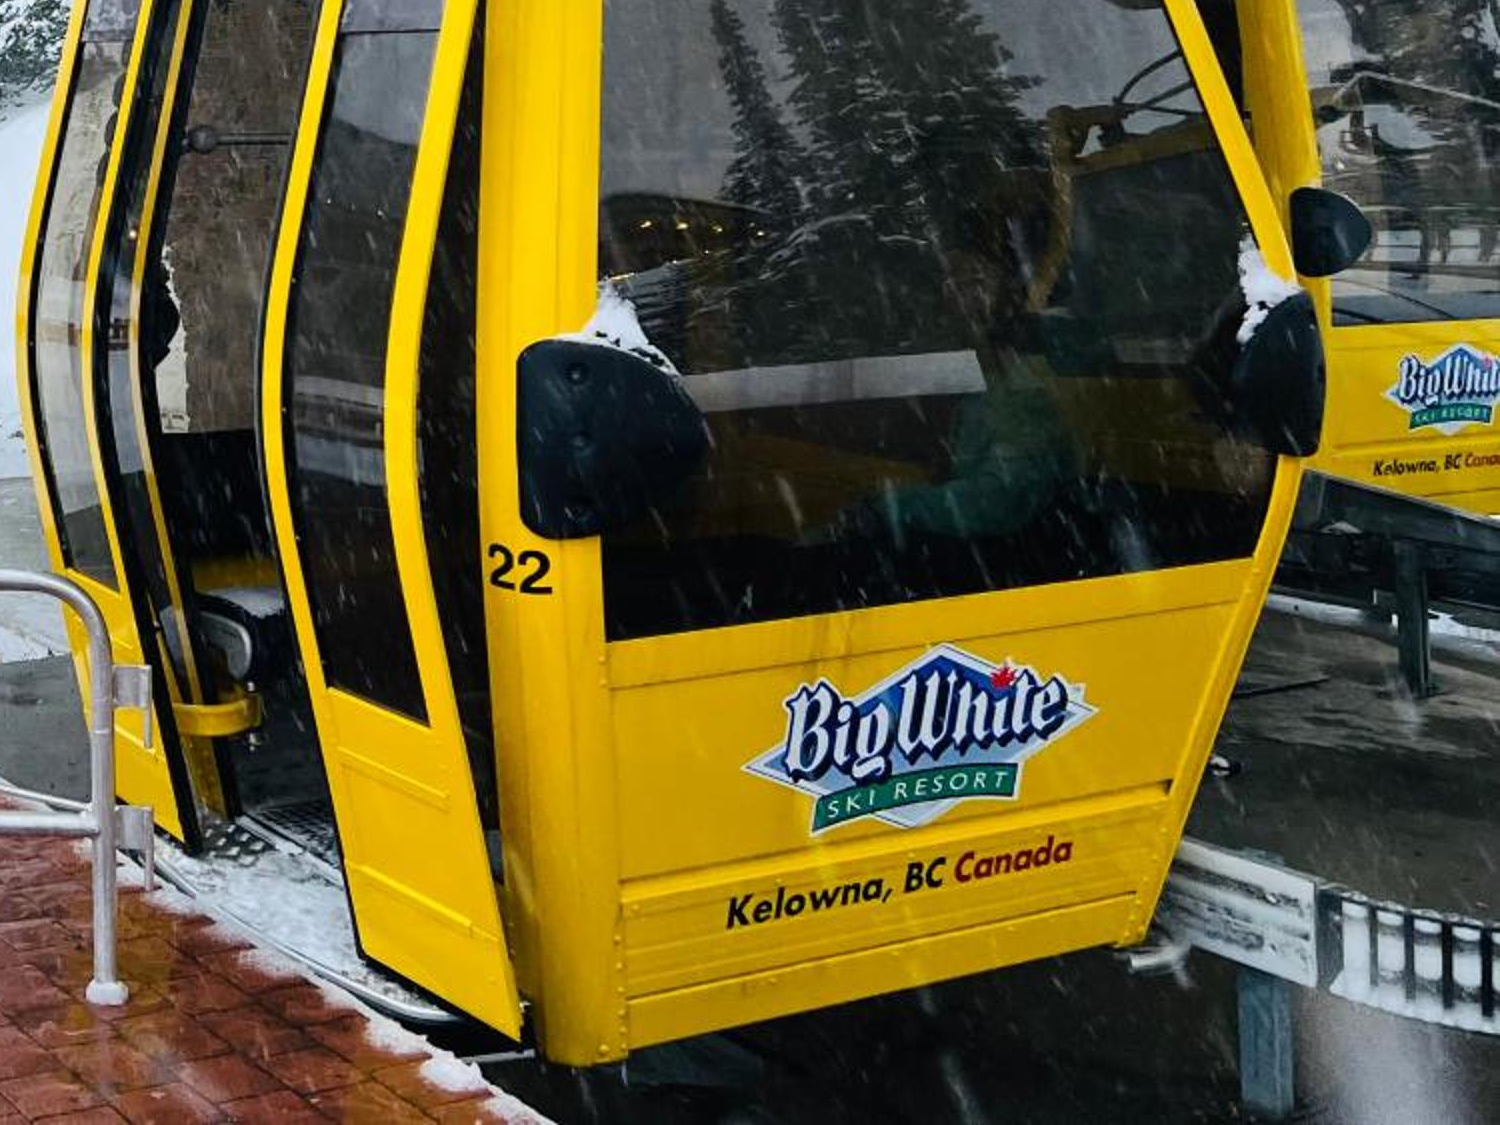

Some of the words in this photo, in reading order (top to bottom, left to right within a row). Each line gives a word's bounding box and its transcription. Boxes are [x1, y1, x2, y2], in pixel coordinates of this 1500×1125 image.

[1399, 355, 1442, 406] Big
[1443, 354, 1500, 399] Whit
[1373, 459, 1440, 476] Kelowna,
[1443, 454, 1462, 470] BC
[488, 542, 553, 595] 22
[784, 681, 893, 783] Big
[897, 668, 1067, 761] White
[827, 790, 877, 818] SKI
[893, 770, 1009, 801] RESORT
[725, 878, 893, 930] Kelowna,
[903, 857, 947, 894] BC
[953, 835, 1074, 883] Canada
